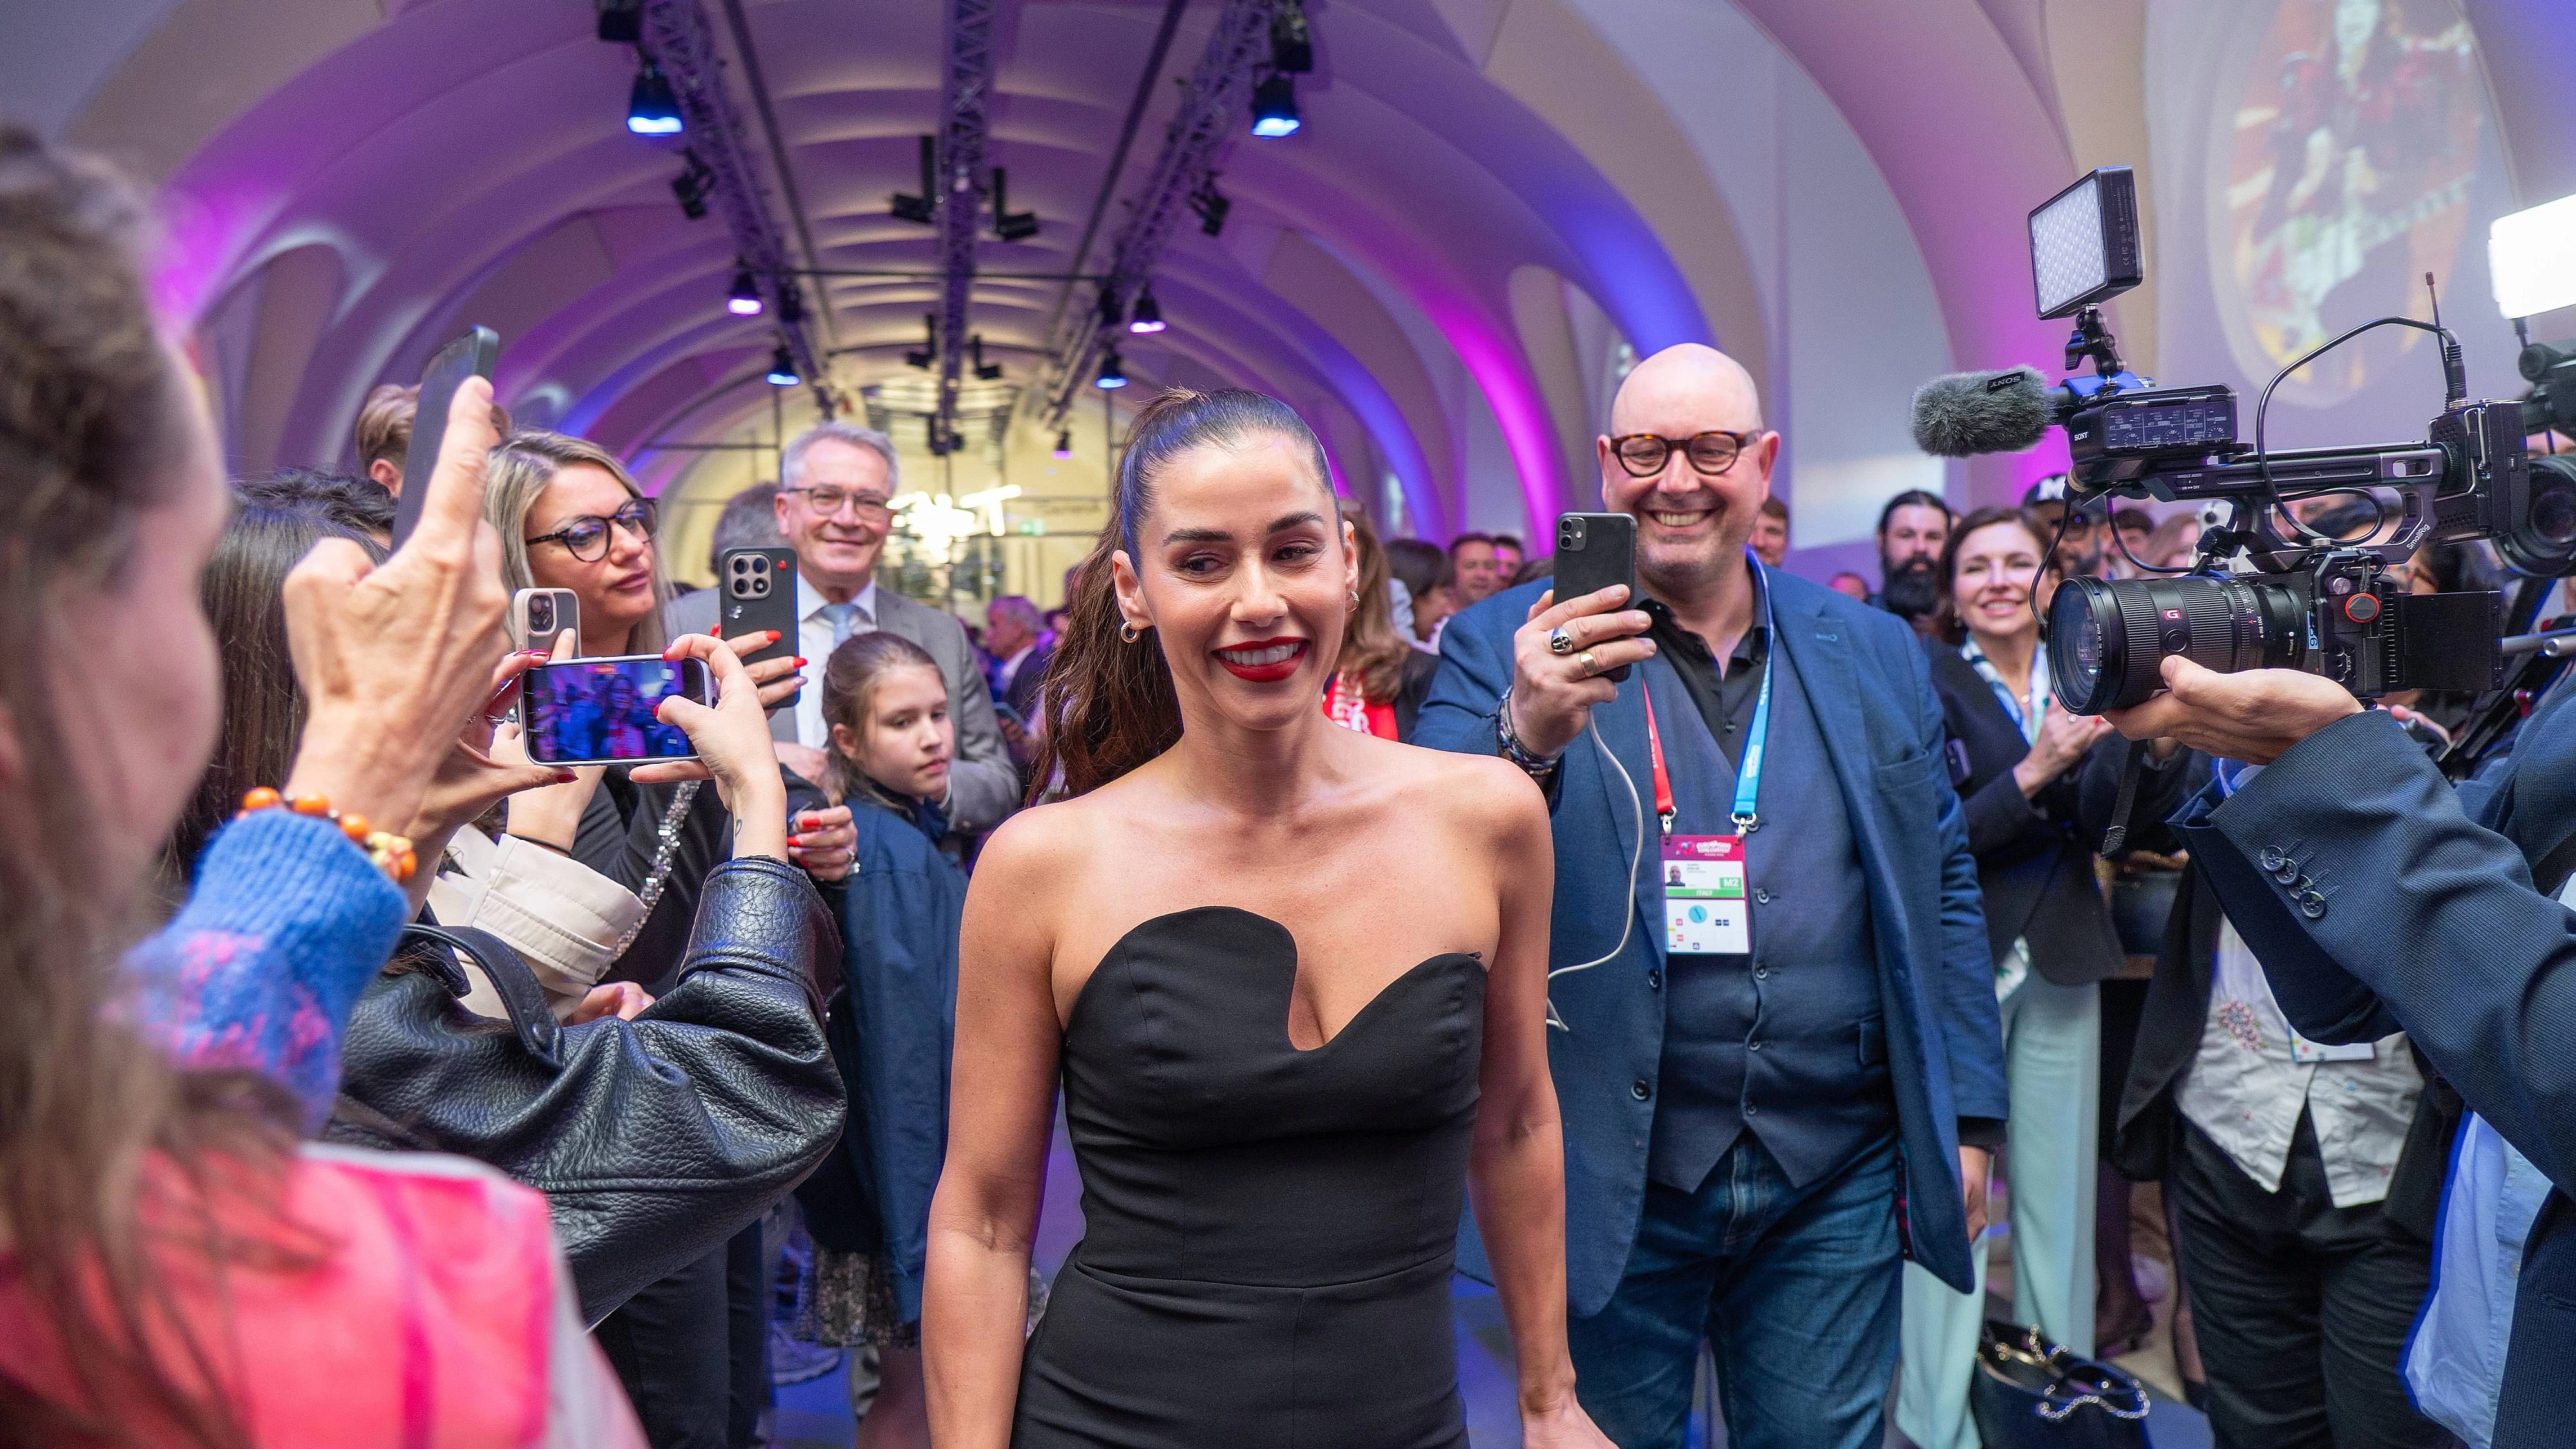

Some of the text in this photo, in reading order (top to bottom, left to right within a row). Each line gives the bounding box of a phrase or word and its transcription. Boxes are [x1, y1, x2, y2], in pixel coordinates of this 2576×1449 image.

[1990, 375, 2021, 388] SONY
[2074, 431, 2088, 442] SONY
[2407, 524, 2430, 550] SmallRig
[2166, 610, 2179, 619] G
[1723, 878, 1739, 887] M2
